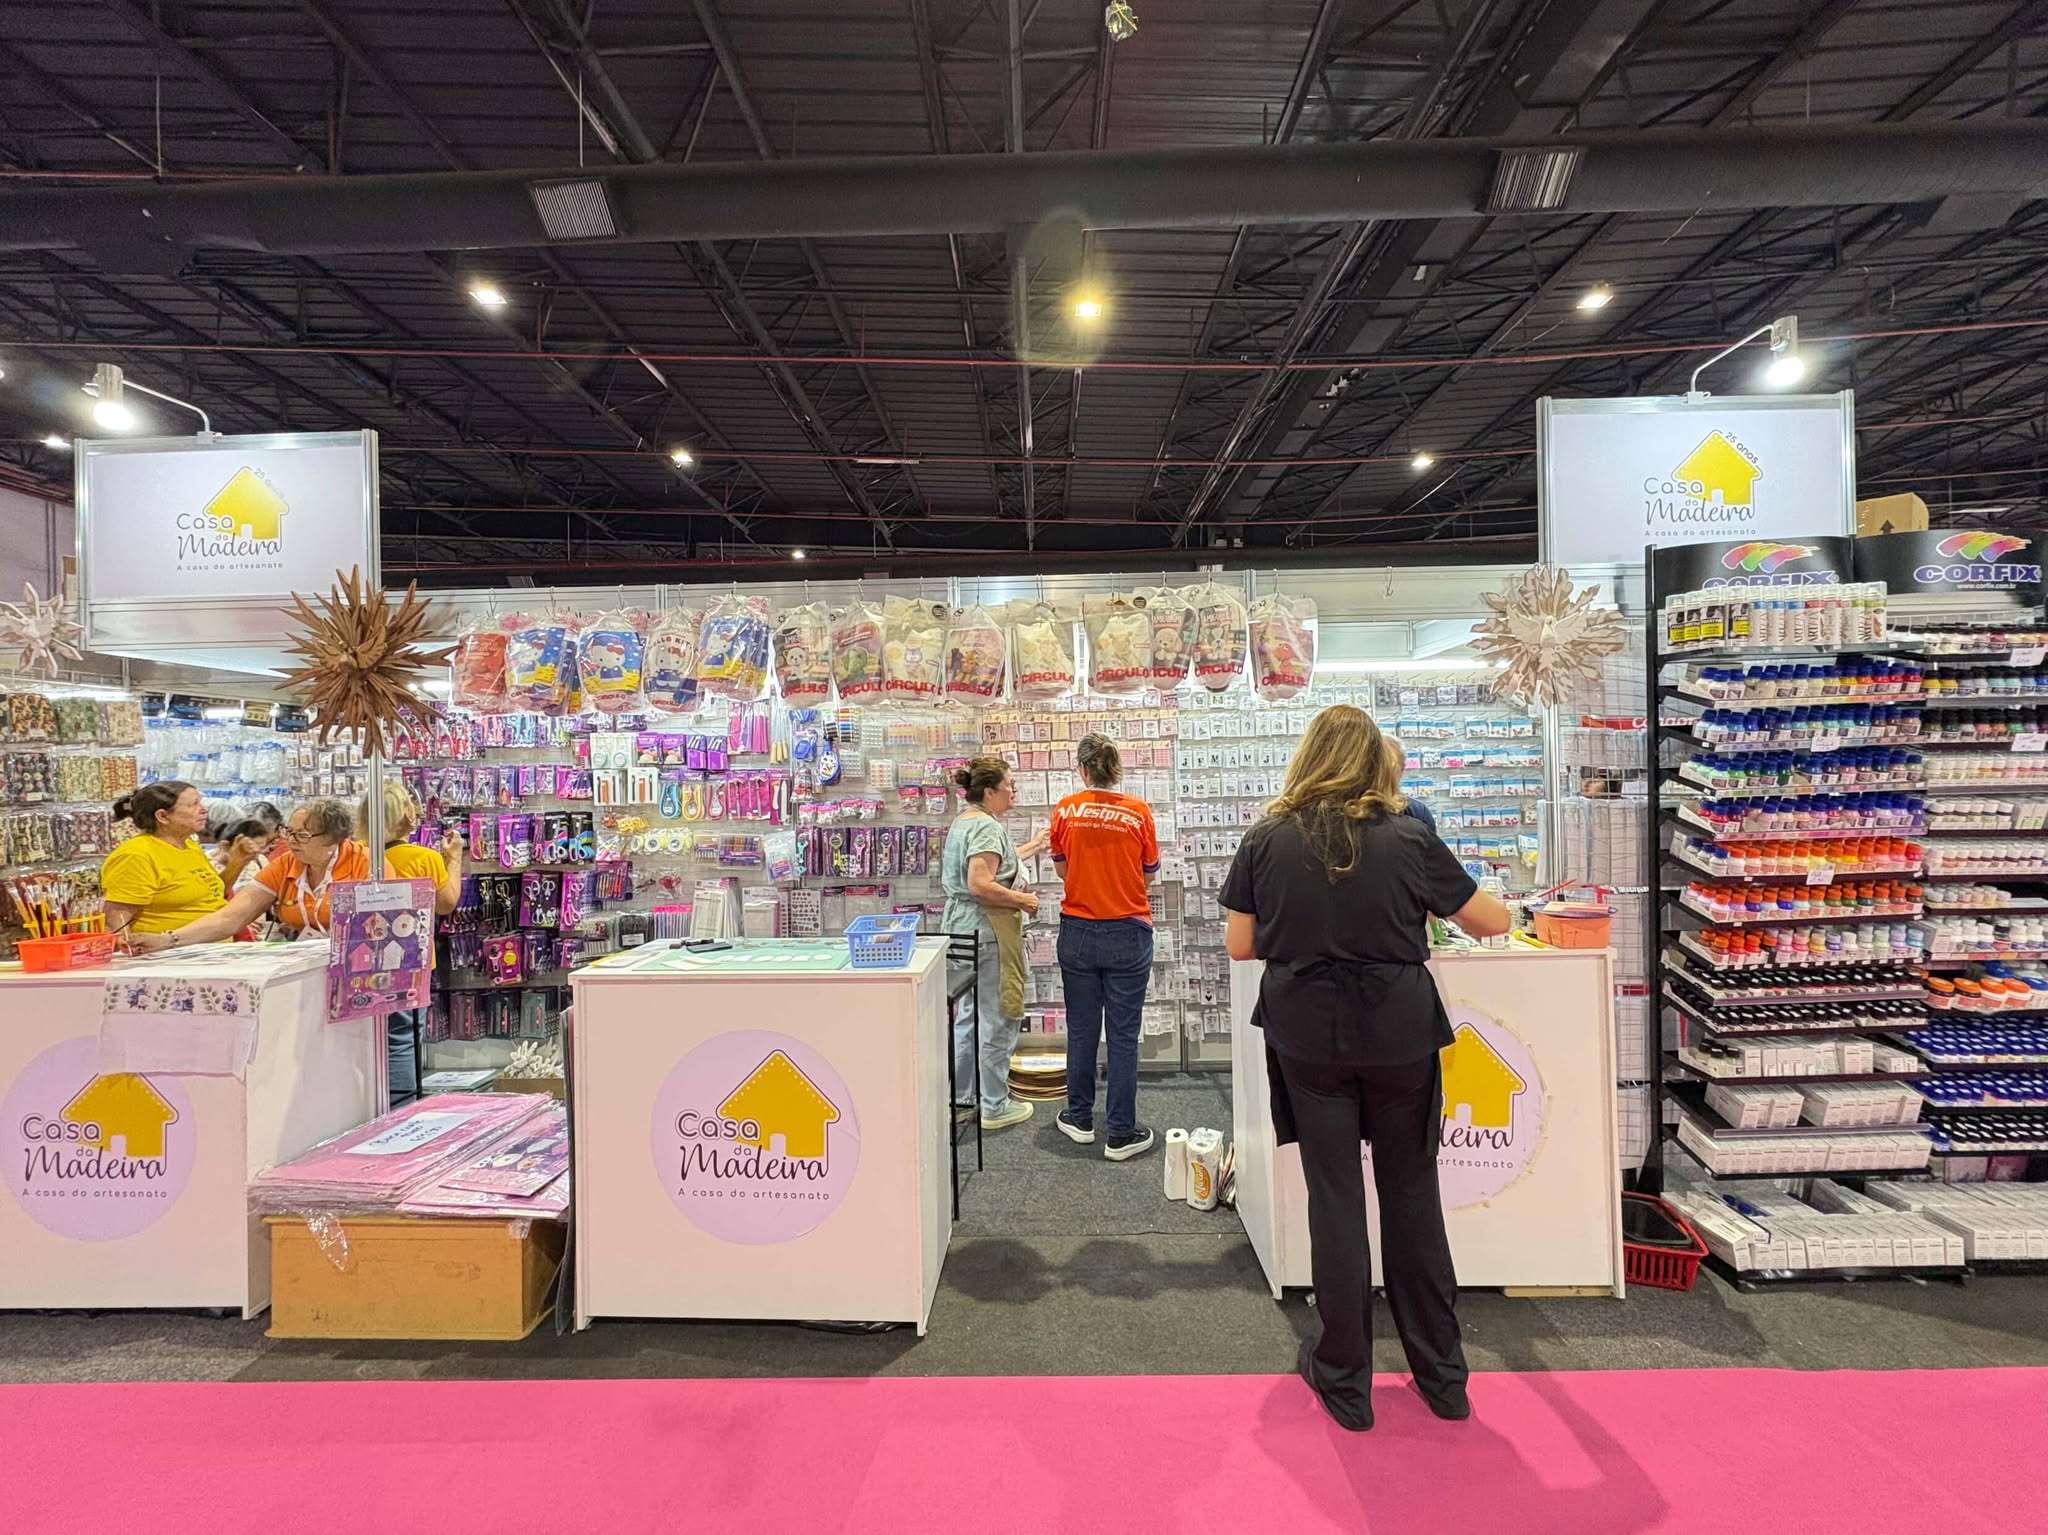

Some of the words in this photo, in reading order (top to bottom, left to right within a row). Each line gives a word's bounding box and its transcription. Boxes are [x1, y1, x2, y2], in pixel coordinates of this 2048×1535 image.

[1725, 432, 1737, 443] 25
[1736, 442, 1759, 464] anos
[1643, 477, 1703, 495] Casa
[1645, 497, 1755, 526] Madeira
[176, 513, 233, 530] Casa
[1699, 528, 1756, 536] artesanato
[177, 532, 282, 560] Madeira
[229, 562, 283, 570] artesanato
[1913, 563, 2042, 583] CORFIX
[1021, 671, 1075, 685] CIRCULO
[22, 1116, 100, 1140] Casa
[677, 1112, 759, 1139] Casa
[75, 1147, 93, 1157] da
[733, 1145, 752, 1156] da
[24, 1145, 167, 1182] Madeira
[679, 1143, 829, 1181] Madeira
[1362, 1153, 1369, 1162] A
[1438, 1158, 1514, 1169] artesanato
[22, 1188, 29, 1196] A
[36, 1189, 65, 1197] casa
[72, 1188, 87, 1197] do
[94, 1189, 168, 1198] artesanato
[678, 1187, 685, 1196] A
[692, 1189, 723, 1197] casa
[730, 1189, 746, 1198] do
[753, 1190, 830, 1200] artesanato
